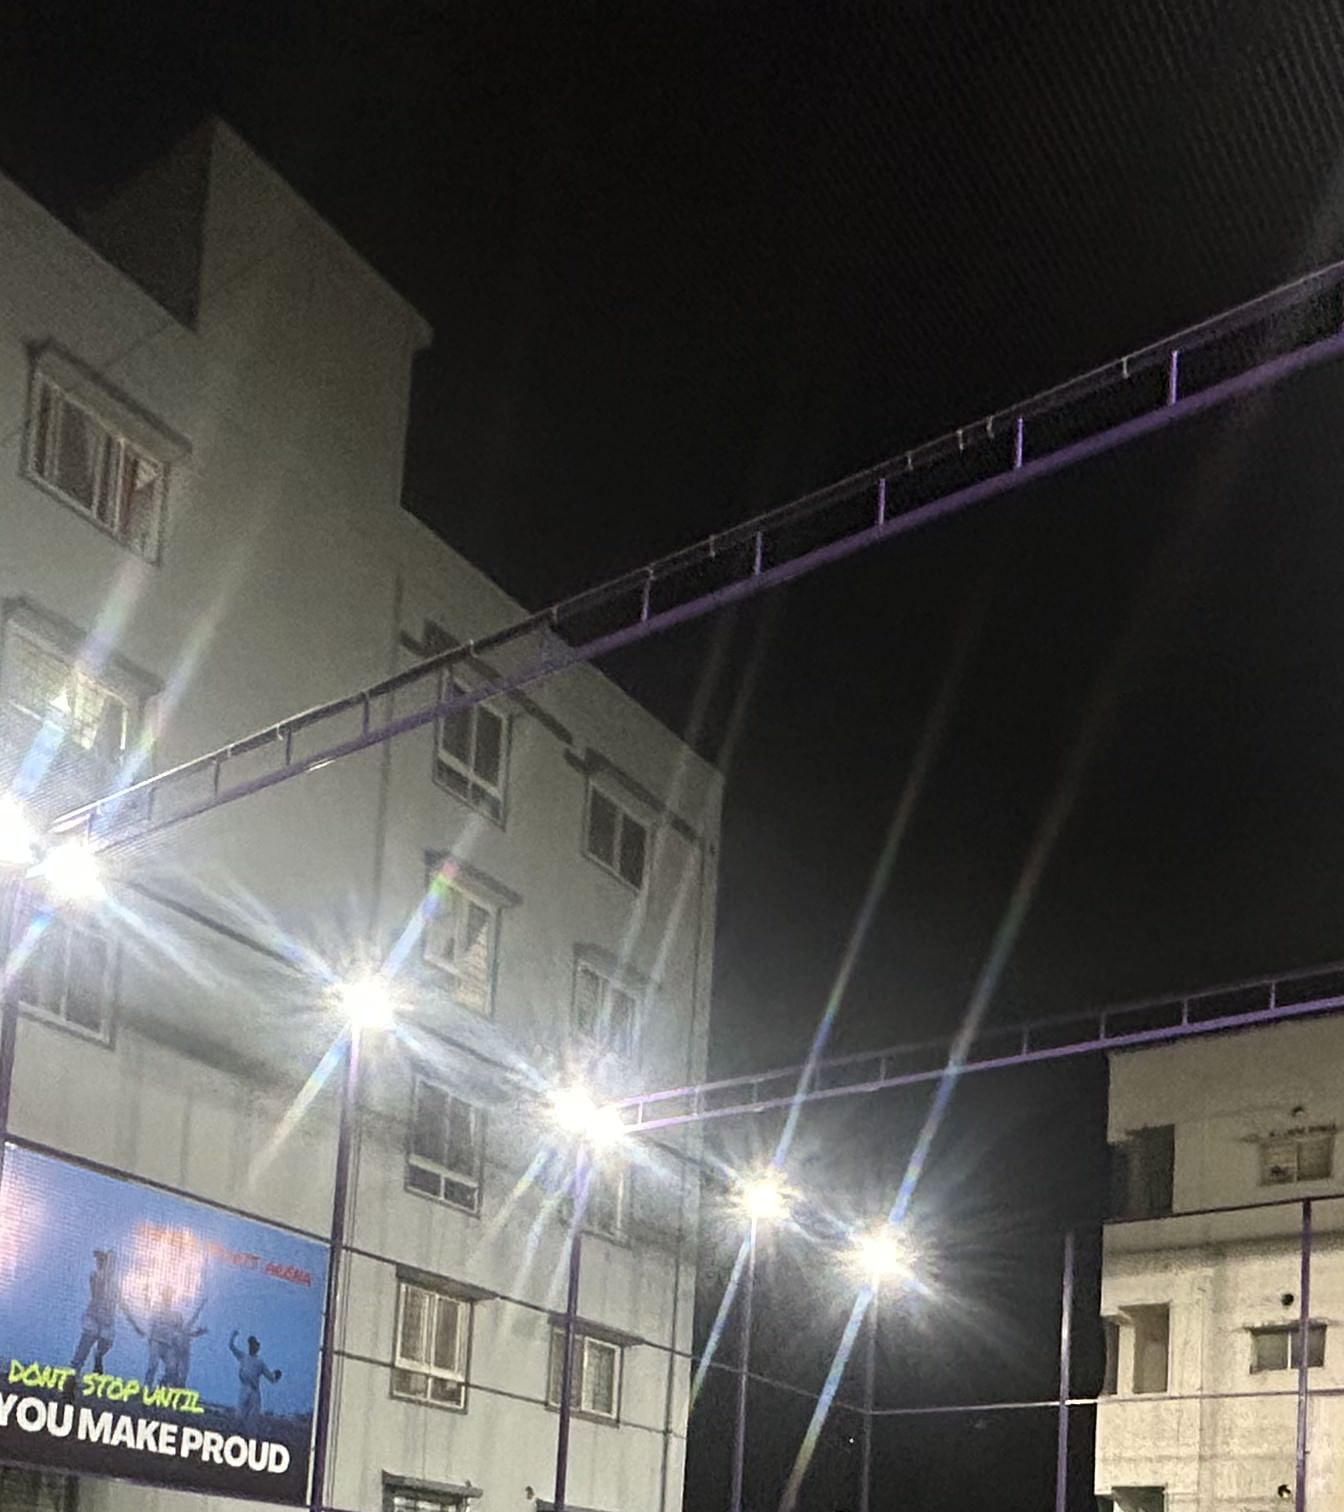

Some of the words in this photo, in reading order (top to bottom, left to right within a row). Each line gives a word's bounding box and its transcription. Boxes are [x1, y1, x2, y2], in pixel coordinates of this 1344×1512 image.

[82, 1372, 140, 1402] STOP
[143, 1385, 205, 1414] UNTIL
[77, 1408, 177, 1456] MAKE
[180, 1427, 291, 1474] PROUD
